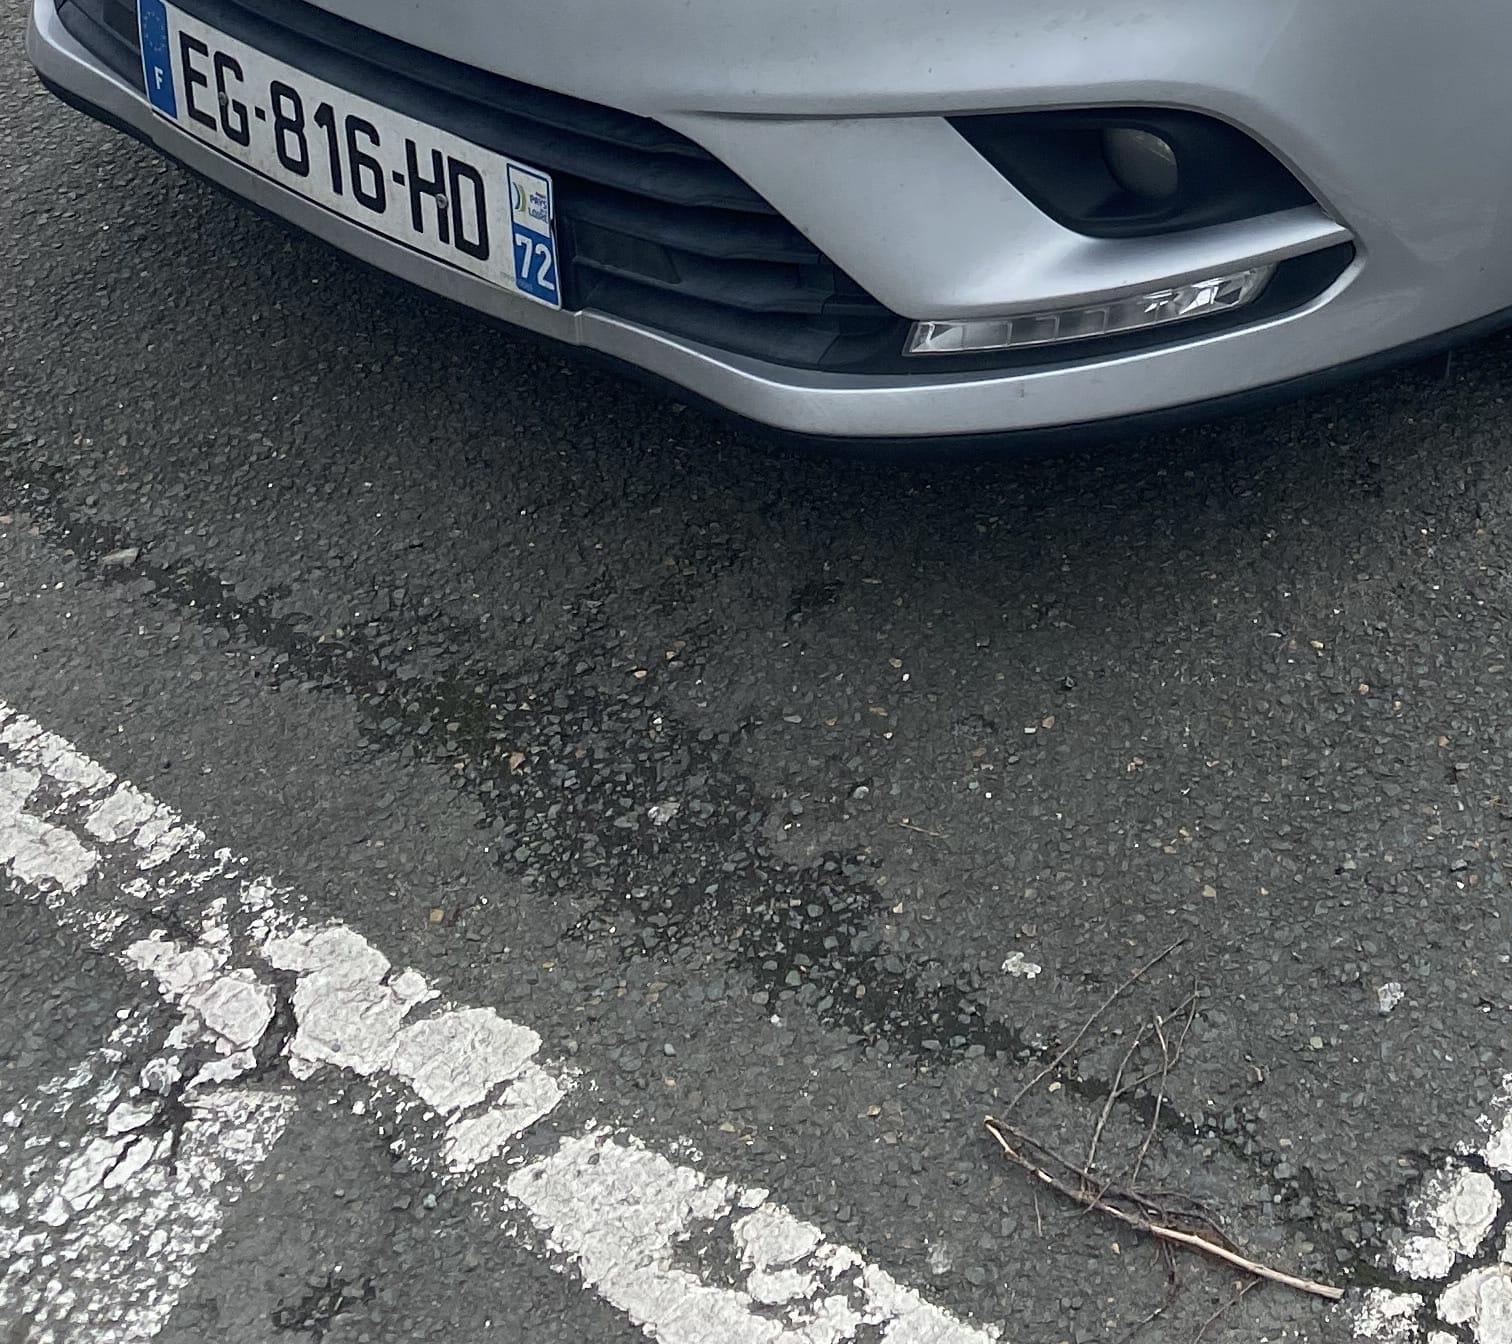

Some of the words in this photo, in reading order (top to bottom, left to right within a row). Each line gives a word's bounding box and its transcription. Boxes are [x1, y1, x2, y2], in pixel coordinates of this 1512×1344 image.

[154, 65, 164, 90] F
[179, 30, 490, 261] EG-816-HD
[515, 234, 555, 292] 72
